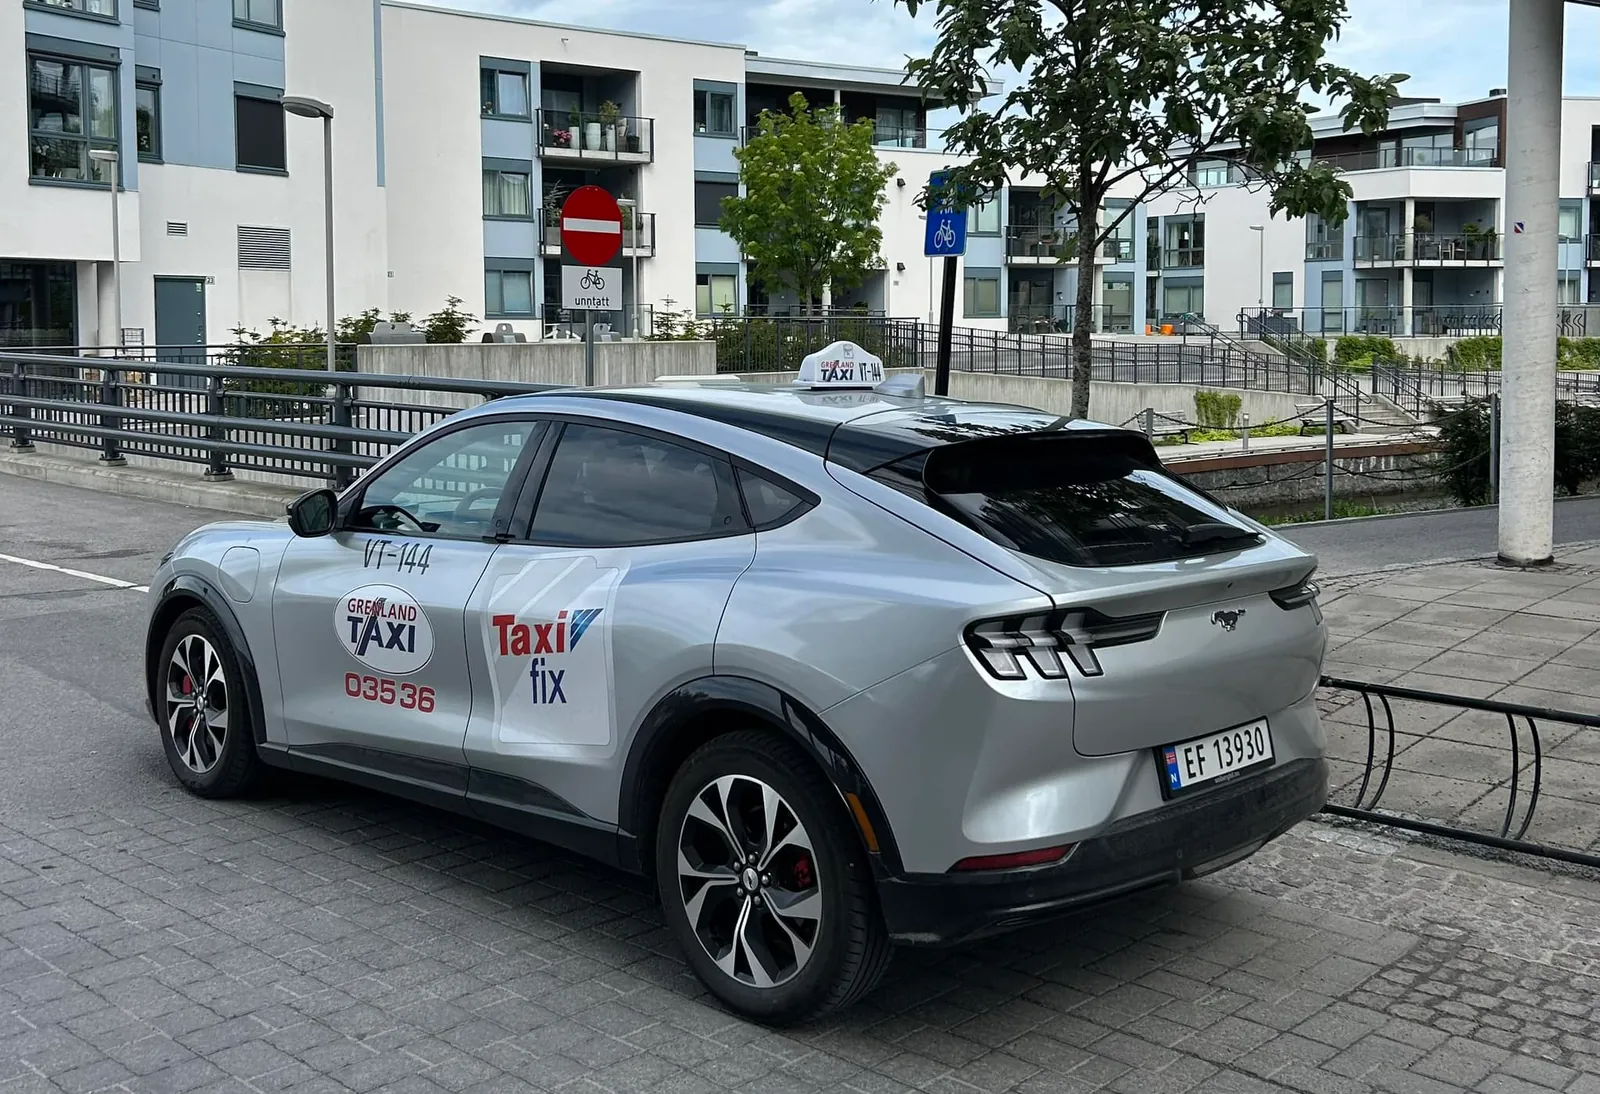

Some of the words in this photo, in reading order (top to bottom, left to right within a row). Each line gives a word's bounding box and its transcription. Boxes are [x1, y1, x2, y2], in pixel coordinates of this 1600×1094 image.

[575, 297, 609, 308] unntatt
[821, 369, 853, 381] TAXI
[364, 538, 434, 575] VT-144
[347, 598, 417, 622] GRENLAND
[347, 615, 416, 656] TAXI
[492, 611, 568, 656] Taxi
[530, 658, 567, 704] fix
[1184, 744, 1206, 779] EF
[1213, 726, 1265, 769] 13930
[1170, 773, 1178, 783] N
